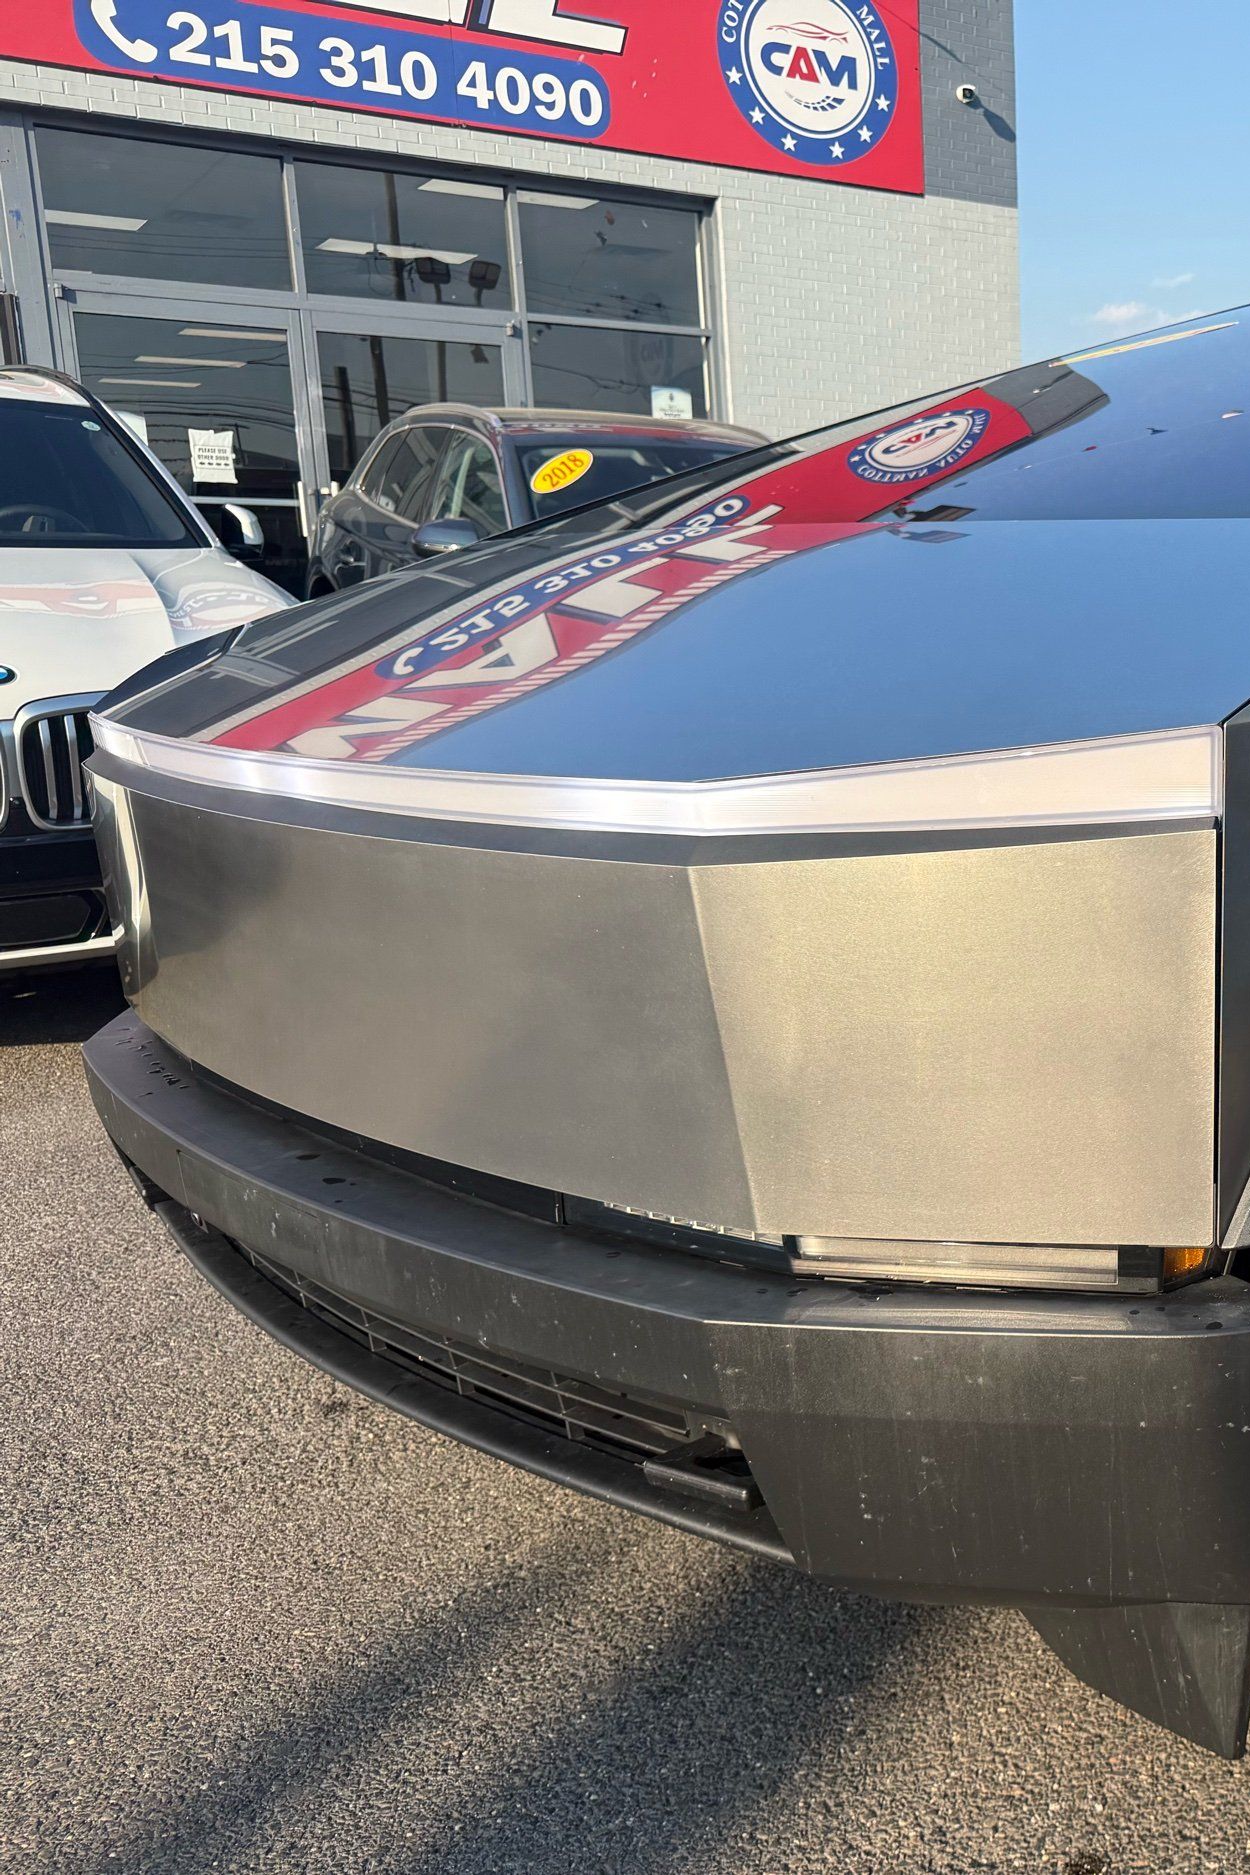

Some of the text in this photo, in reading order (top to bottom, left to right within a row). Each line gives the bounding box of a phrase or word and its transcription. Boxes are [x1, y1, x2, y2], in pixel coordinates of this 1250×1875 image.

[856, 4, 890, 70] MALL
[165, 12, 300, 79] 215
[318, 37, 437, 100] 310
[456, 61, 603, 126] 4090
[761, 42, 858, 91] CAM
[543, 453, 585, 489] 2018
